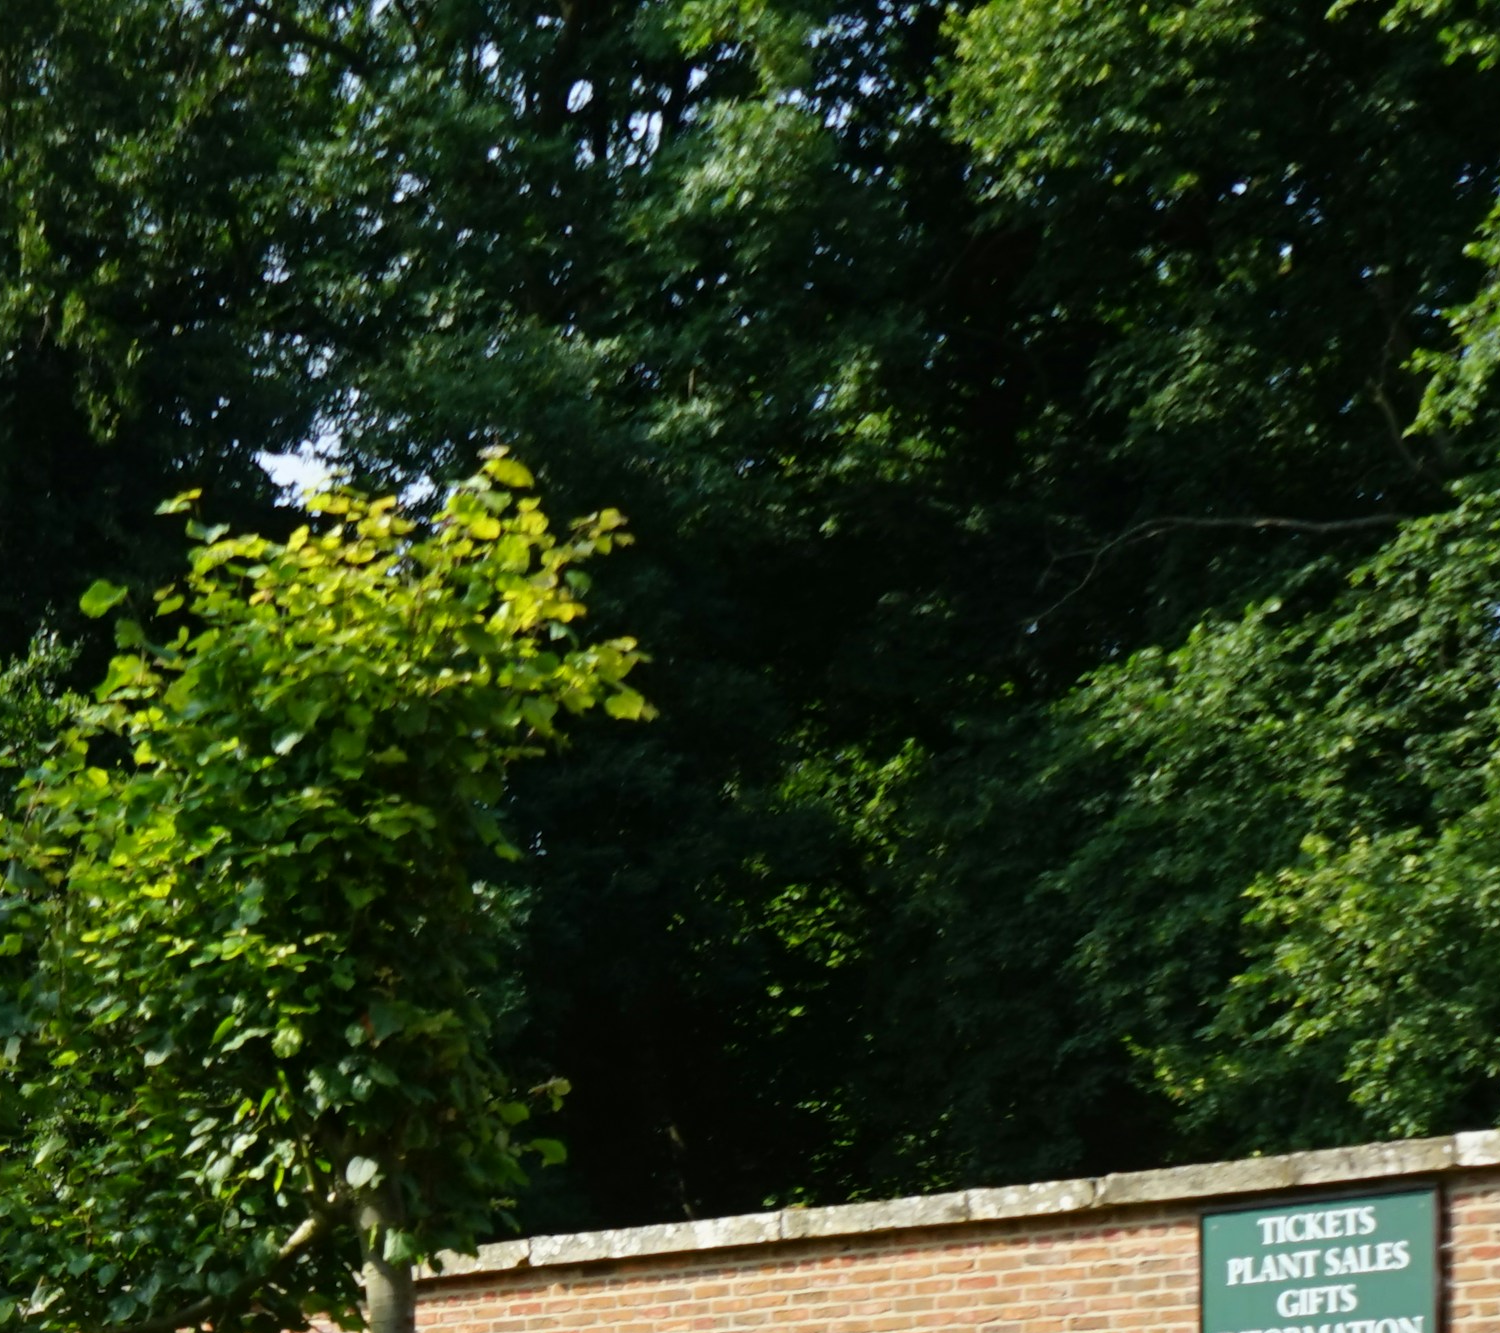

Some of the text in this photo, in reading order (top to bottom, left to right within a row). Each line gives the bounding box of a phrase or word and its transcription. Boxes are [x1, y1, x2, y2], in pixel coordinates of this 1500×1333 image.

[1256, 1206, 1377, 1245] TICKETS
[1225, 1240, 1411, 1286] PLANT SALES
[1276, 1284, 1358, 1317] GIFTS
